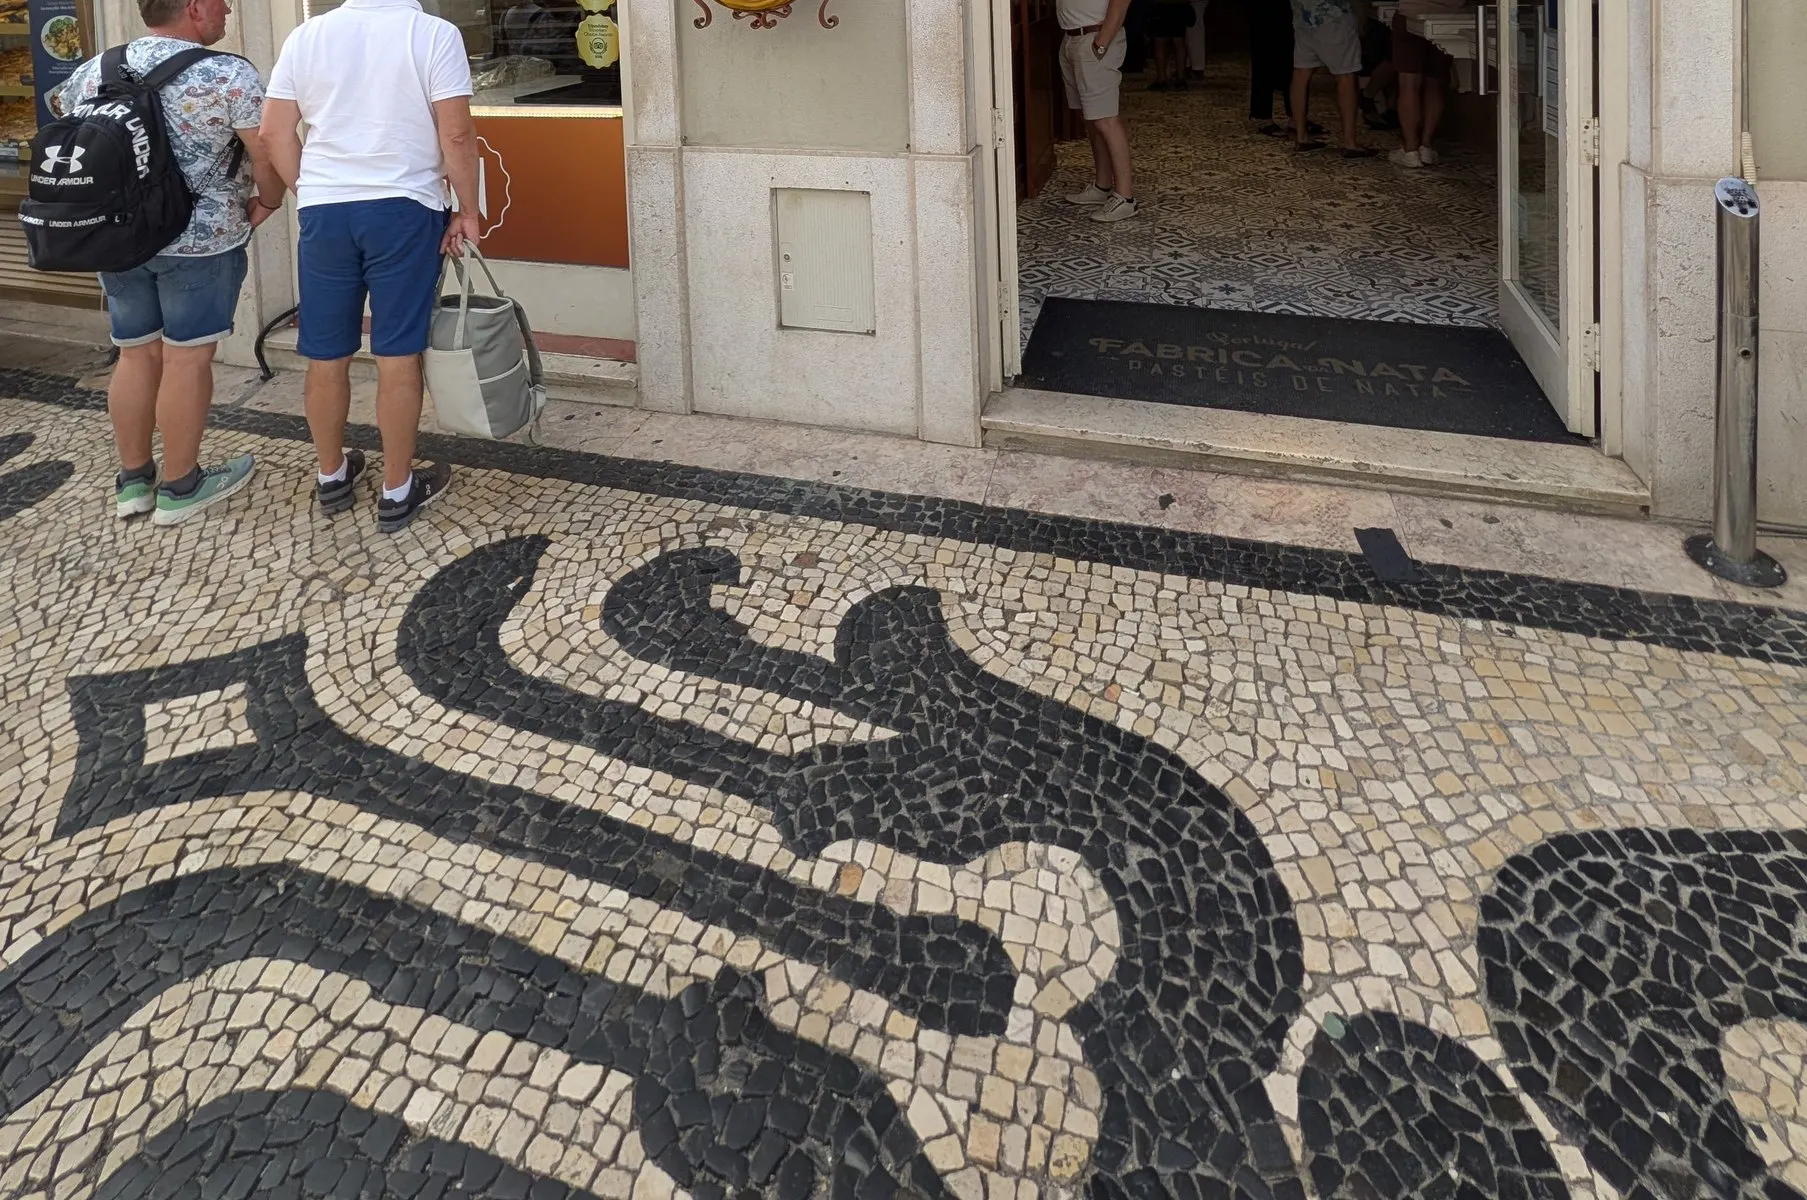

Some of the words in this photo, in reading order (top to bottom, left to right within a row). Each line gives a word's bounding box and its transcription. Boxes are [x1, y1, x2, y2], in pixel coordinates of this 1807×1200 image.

[125, 116, 151, 180] UNDER
[31, 175, 56, 185] UNDER
[56, 175, 94, 186] ARMOUR
[196, 175, 212, 195] NDER
[49, 220, 73, 228] UNDER
[73, 215, 106, 228] ARMOUR
[1316, 356, 1472, 387] NATA
[1293, 374, 1334, 393] DE
[1356, 380, 1448, 399] NATA
